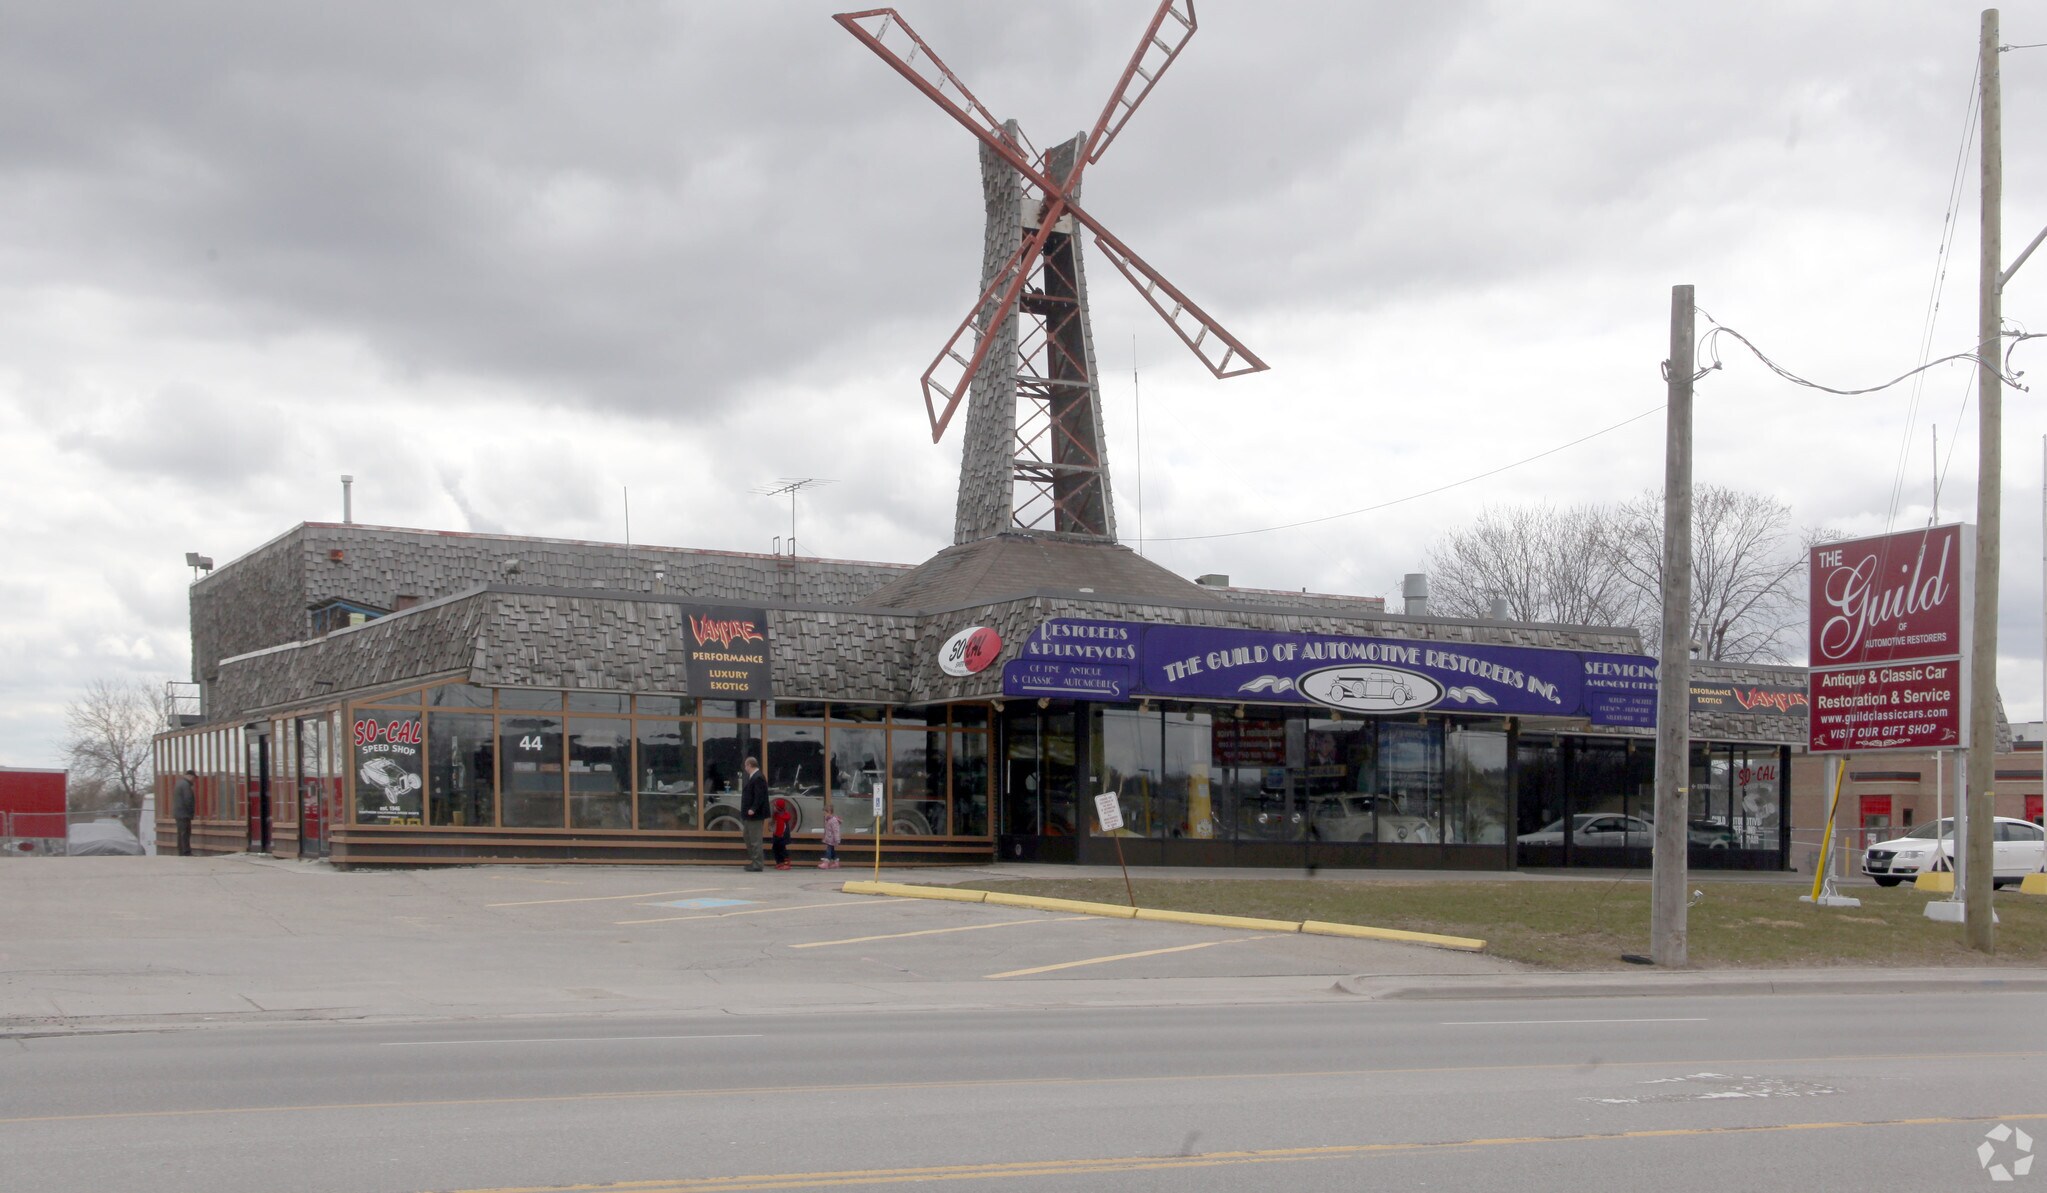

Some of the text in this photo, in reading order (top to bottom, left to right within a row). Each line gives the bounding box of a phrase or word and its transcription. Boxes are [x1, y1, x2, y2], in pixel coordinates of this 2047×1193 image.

[1819, 550, 1843, 568] THE
[1820, 535, 1951, 659] Guild
[689, 613, 764, 650] VAMPIRE
[1041, 622, 1128, 640] RESTORERS
[1899, 622, 1908, 631] OF
[1865, 632, 1947, 648] AUTOMOTIVE RESTORERS
[693, 652, 764, 664] PERFORMANCE
[1029, 642, 1136, 660] & PURVEYORS
[1069, 666, 1102, 676] ANTIQUE
[1163, 655, 1204, 682] THE
[1206, 646, 1269, 670] GUILD
[1272, 643, 1298, 662] OF
[1302, 642, 1420, 665] AUTOMOTIVE
[1425, 649, 1525, 689] RESTORERS
[709, 670, 748, 679] LUXURY
[1022, 675, 1054, 684] CLASSIC
[1822, 666, 1947, 689] Antique & Classic Car
[711, 682, 749, 691] EXOTICS
[1586, 679, 1629, 689] AMONGST
[1689, 687, 1732, 696] ERFORMANCE
[1733, 687, 1808, 713] VAMPIR
[1818, 688, 1951, 709] Restoration & Service
[1820, 709, 1948, 725] www.guildclassiccars.com
[354, 719, 422, 746] SO-CAL
[1830, 723, 1937, 739] VISIT OUR GIFT SHOP
[362, 744, 416, 756] SPEED SHOP
[519, 735, 543, 751] 44
[1738, 766, 1775, 786] SO-CAL
